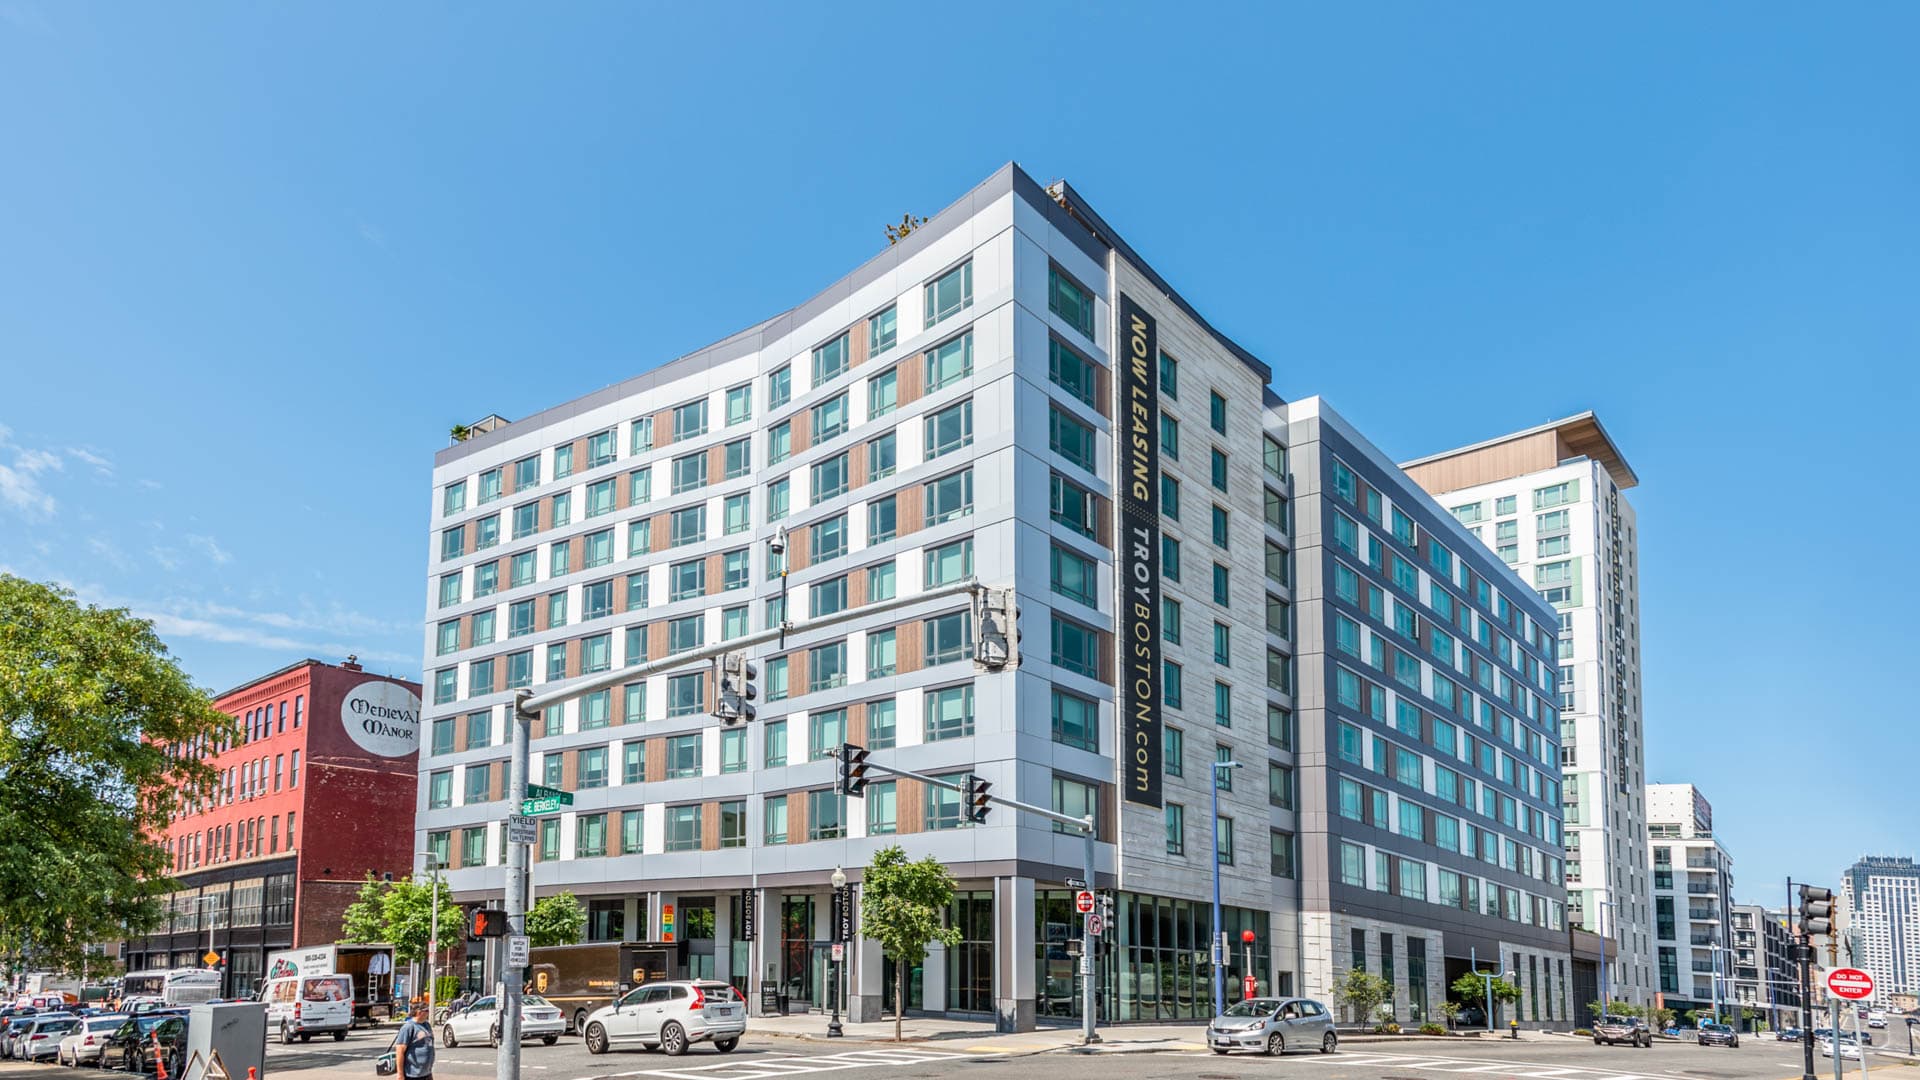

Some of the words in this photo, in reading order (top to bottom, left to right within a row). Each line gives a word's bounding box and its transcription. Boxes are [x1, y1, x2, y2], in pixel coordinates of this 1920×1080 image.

[1131, 313, 1148, 385] NOW
[1132, 386, 1150, 502] LEASING
[1133, 526, 1151, 793] TROYBOSTON.com
[363, 718, 413, 740] MANOR
[511, 816, 536, 825] YIELD
[533, 799, 557, 812] BERKELEY
